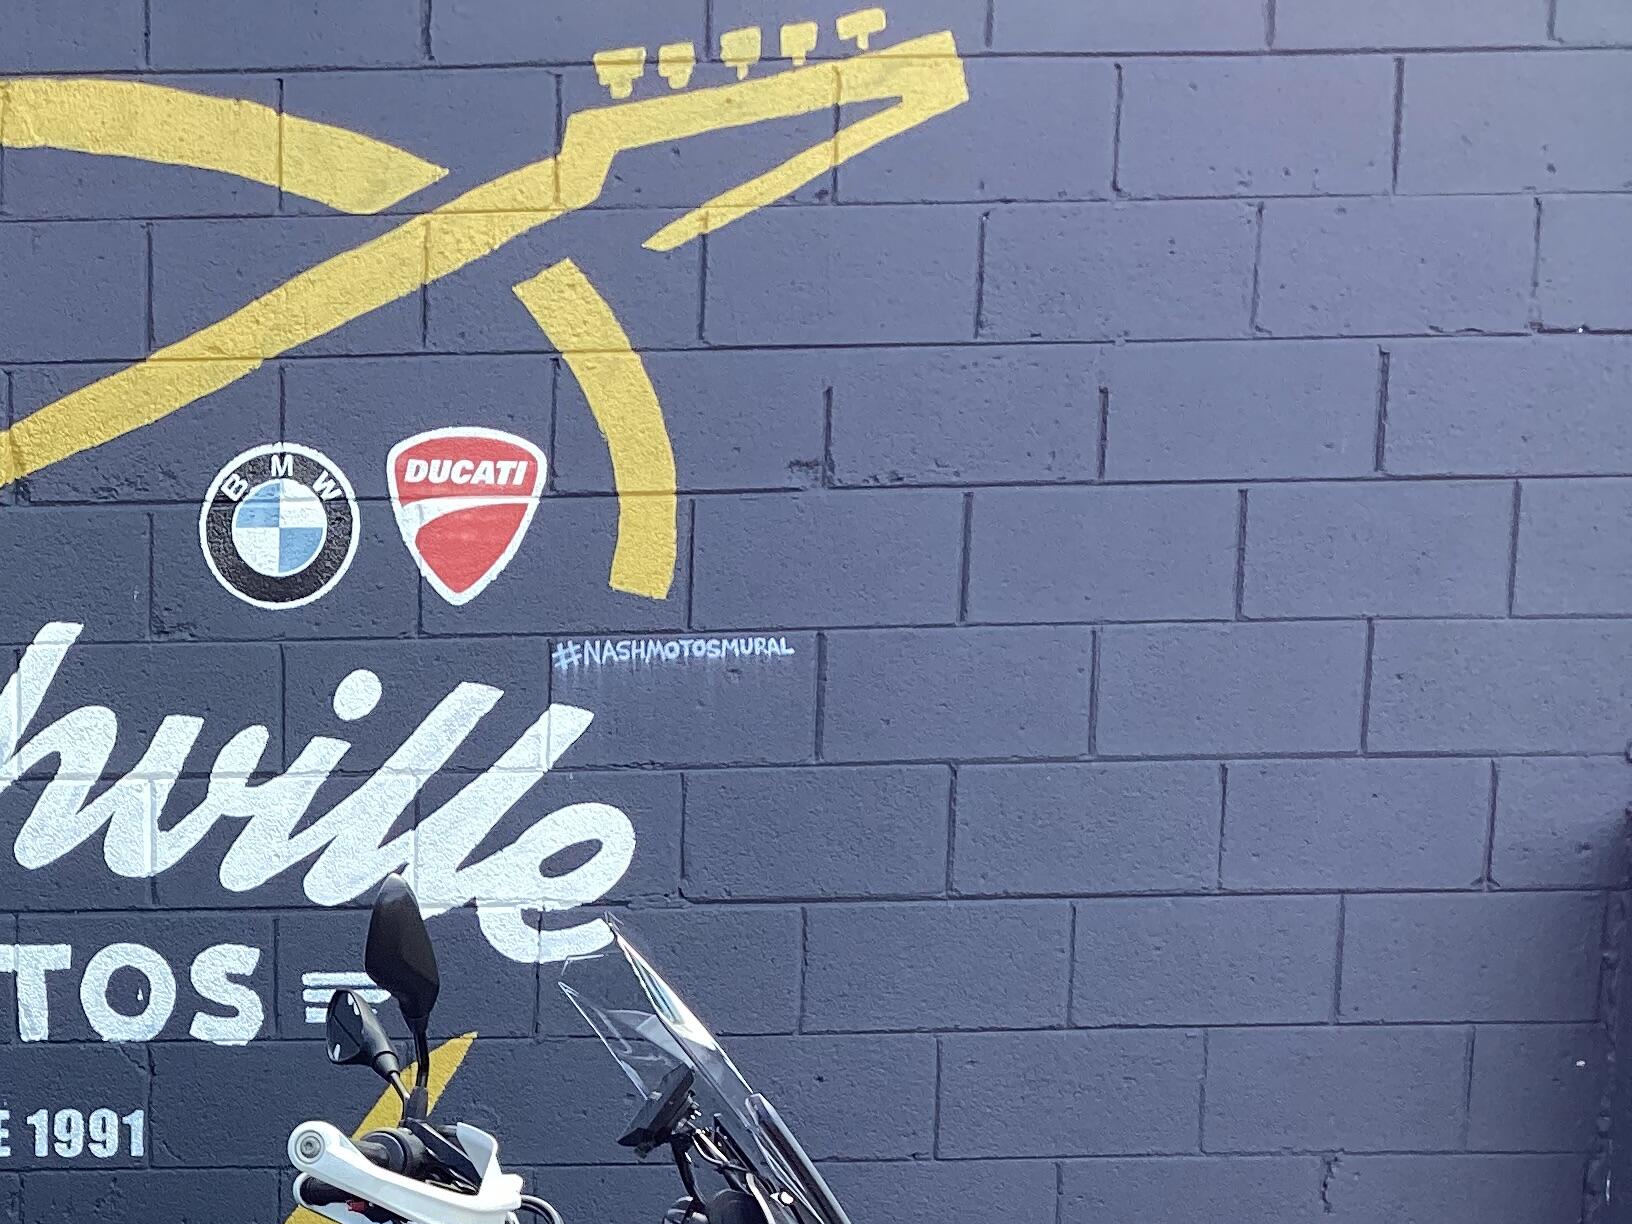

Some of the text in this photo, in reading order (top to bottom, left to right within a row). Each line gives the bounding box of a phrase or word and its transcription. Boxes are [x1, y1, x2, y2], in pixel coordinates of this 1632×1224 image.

[219, 453, 345, 502] BMW
[403, 457, 529, 486] DUCATI
[551, 636, 796, 670] #NASHMOTOSMURAL
[27, 1107, 146, 1158] 1991
